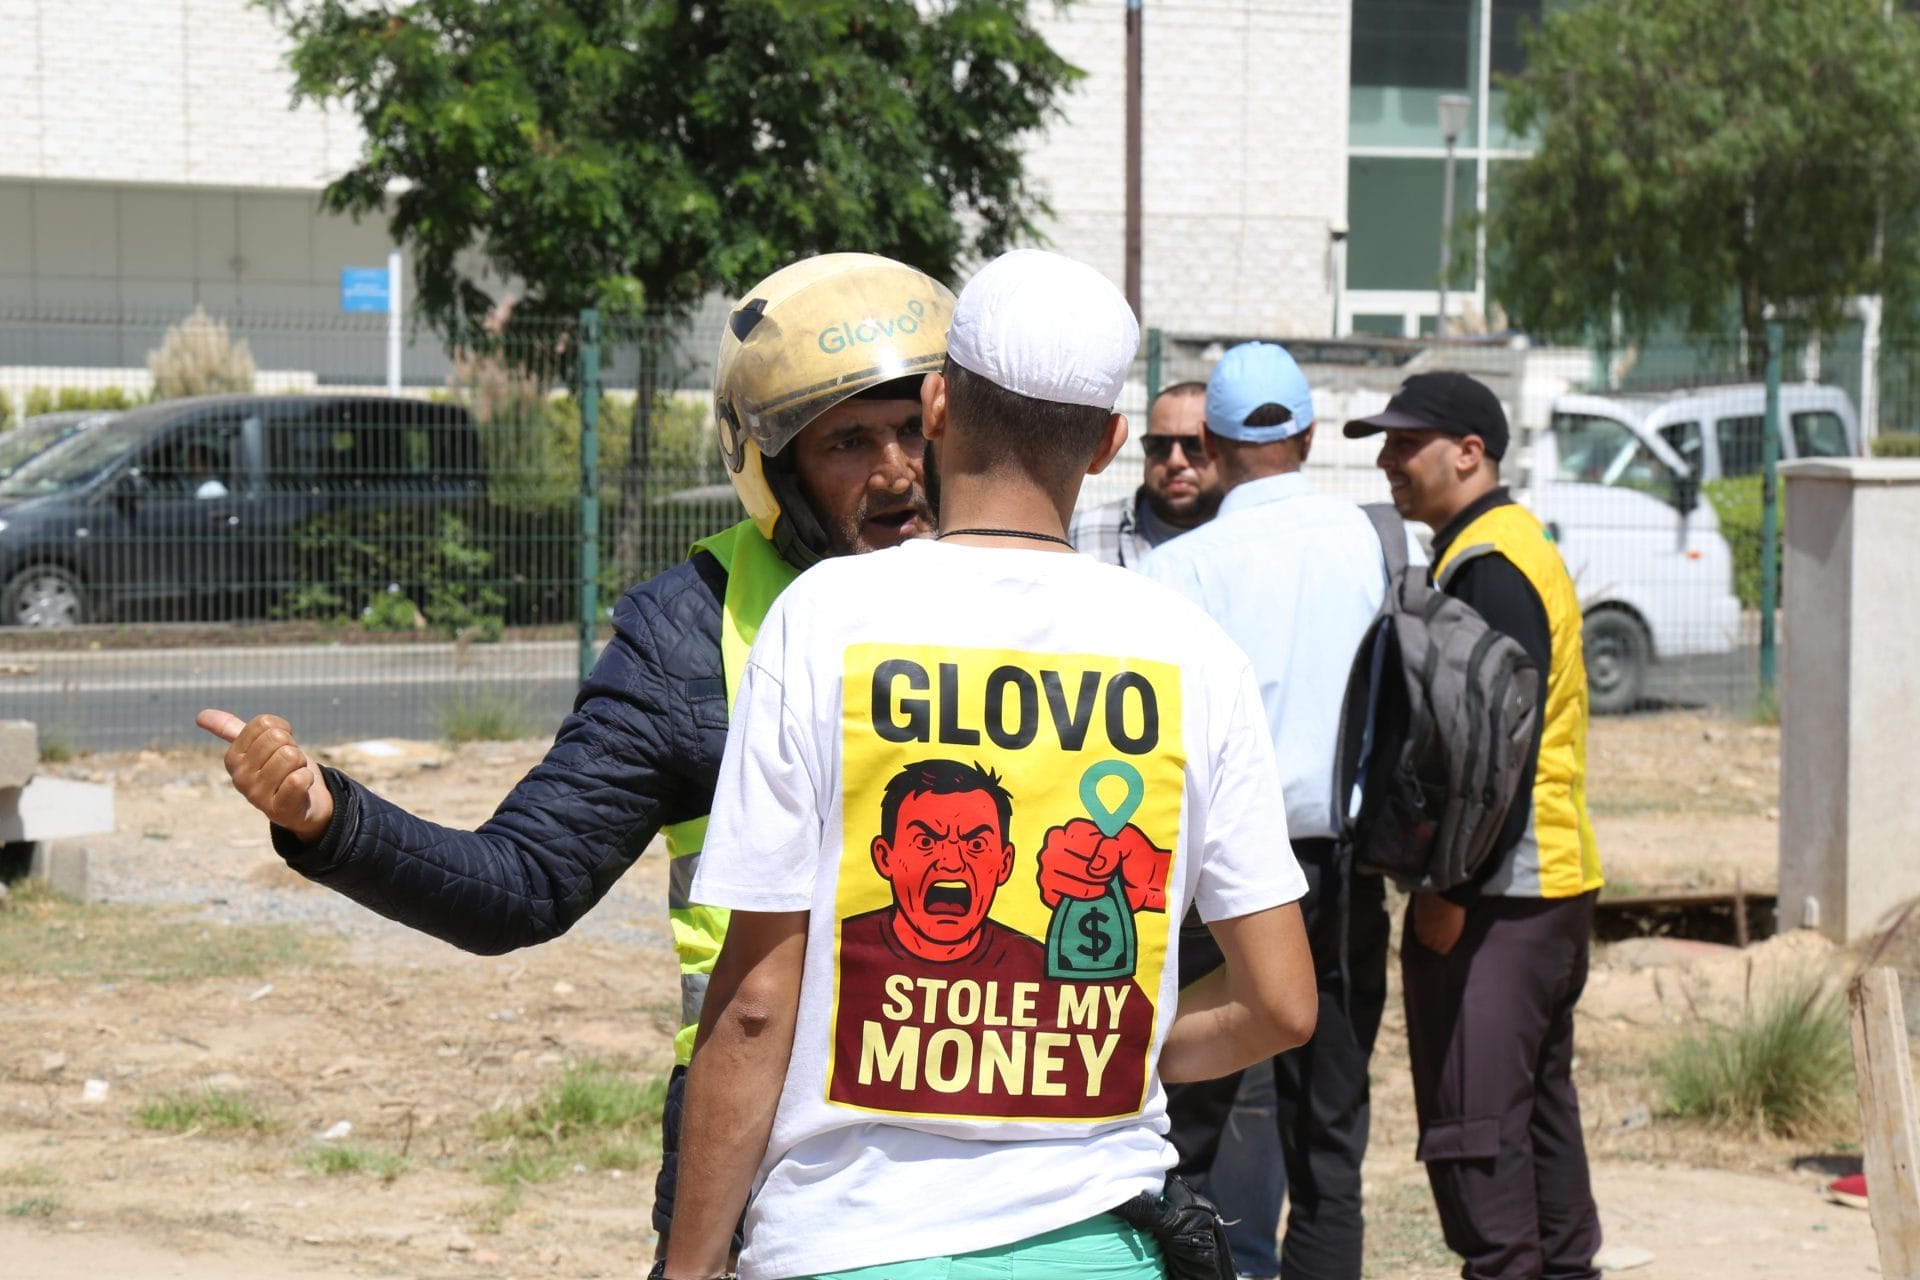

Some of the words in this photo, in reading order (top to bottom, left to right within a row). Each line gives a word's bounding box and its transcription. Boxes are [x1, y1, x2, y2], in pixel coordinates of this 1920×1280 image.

[818, 315, 918, 354] Glovo
[872, 660, 1158, 755] GLOVO
[882, 975, 1038, 1026] STOLE
[1057, 985, 1132, 1029] MY
[858, 1021, 1120, 1097] MONEY
